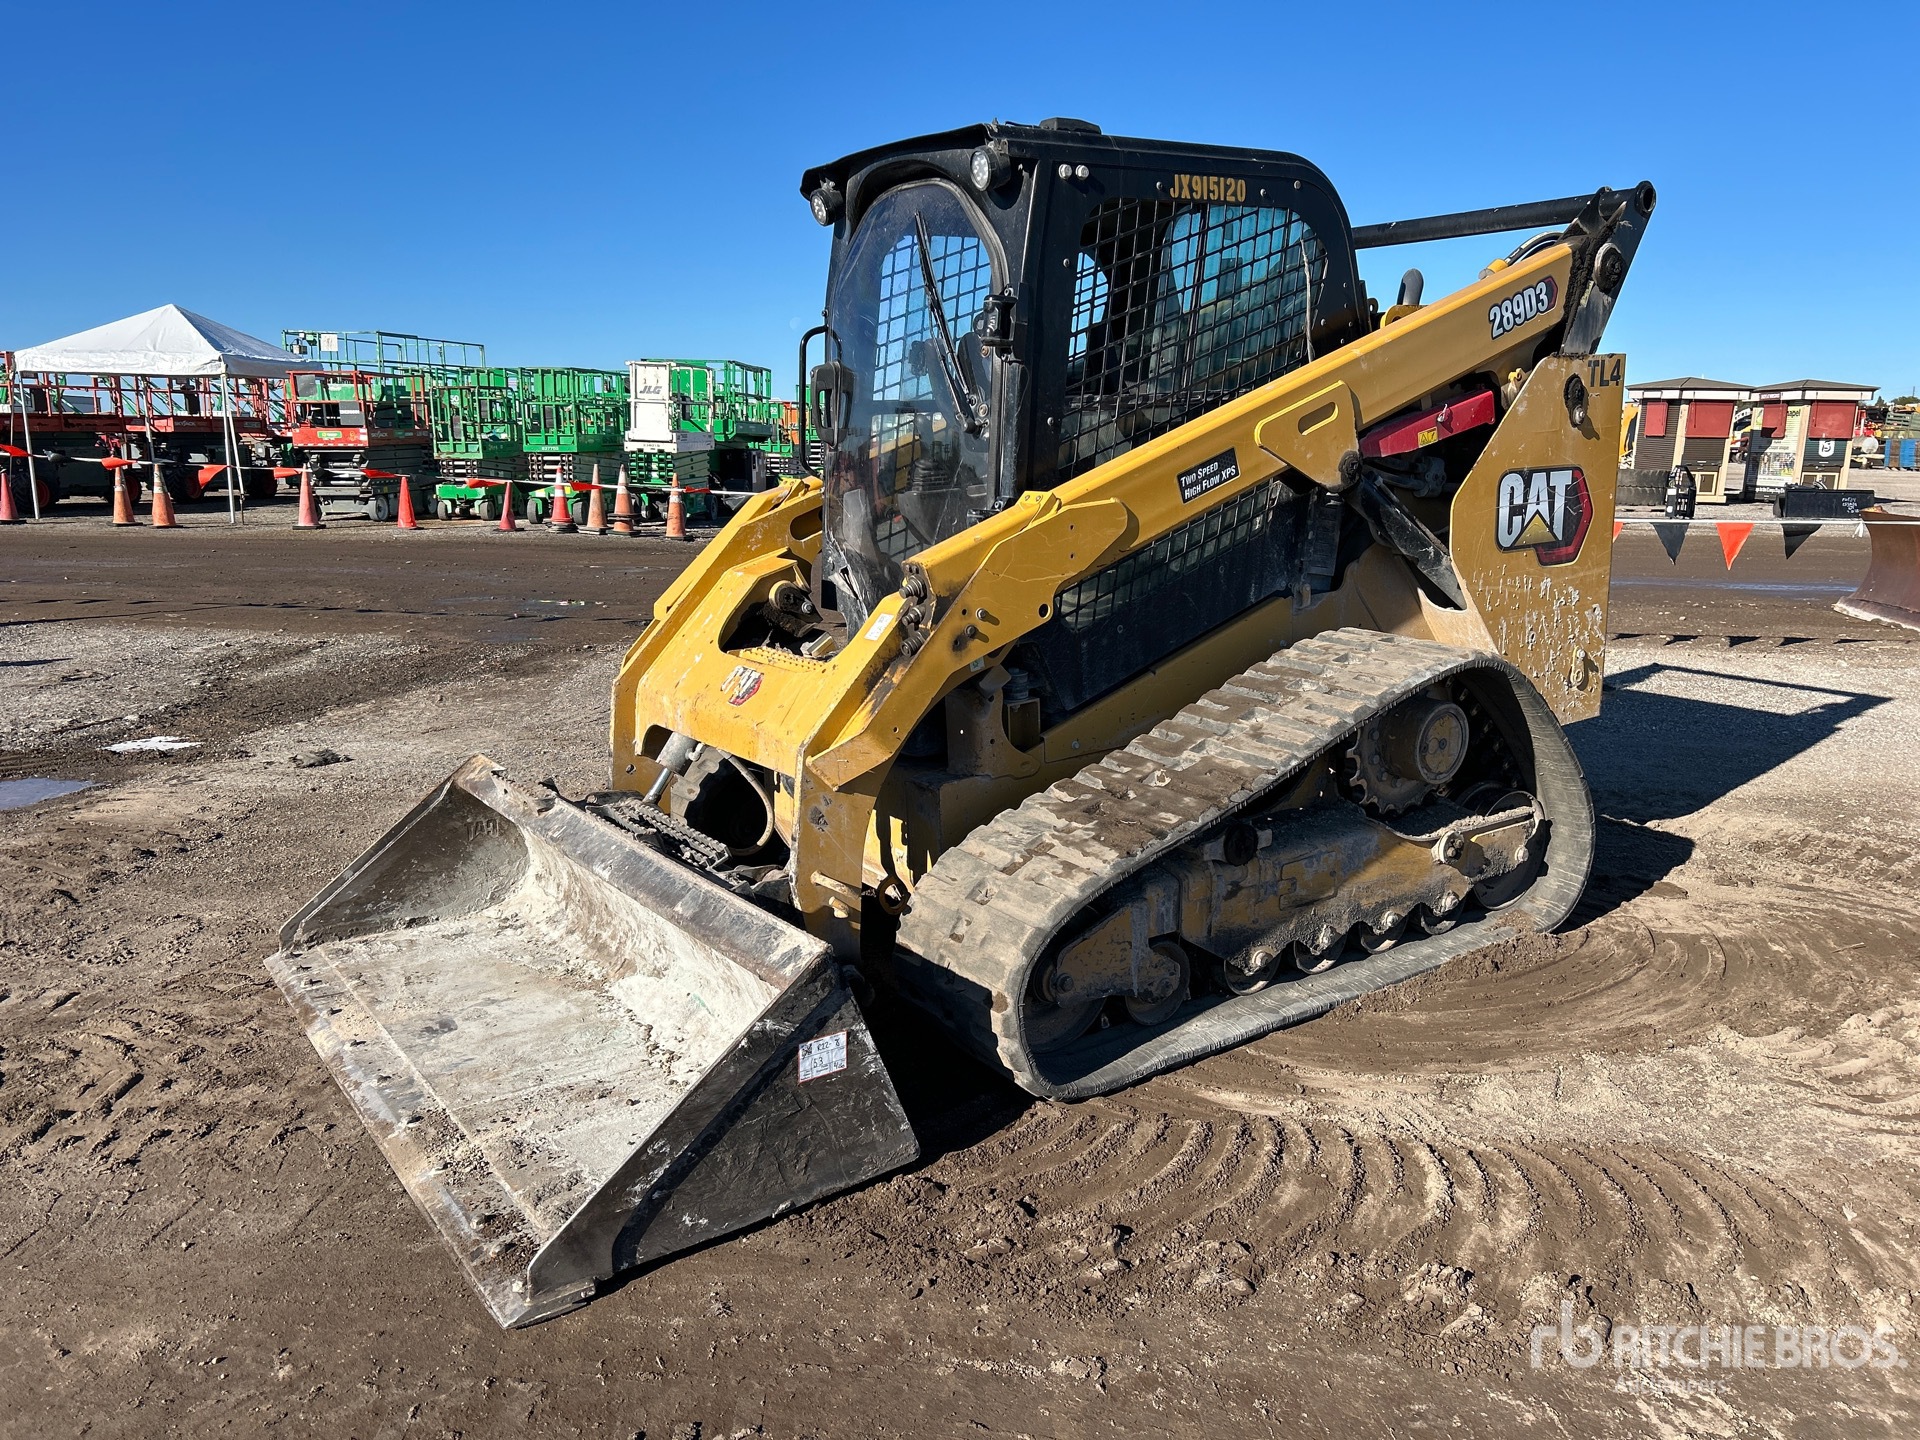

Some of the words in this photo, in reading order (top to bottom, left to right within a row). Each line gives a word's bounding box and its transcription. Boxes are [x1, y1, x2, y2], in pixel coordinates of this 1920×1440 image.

[1169, 174, 1246, 202] JX915120
[1488, 280, 1550, 340] 289D3
[1588, 359, 1622, 387] TL4
[639, 385, 662, 394] JLG
[1221, 465, 1236, 481] XPS
[1498, 470, 1573, 548] CAT
